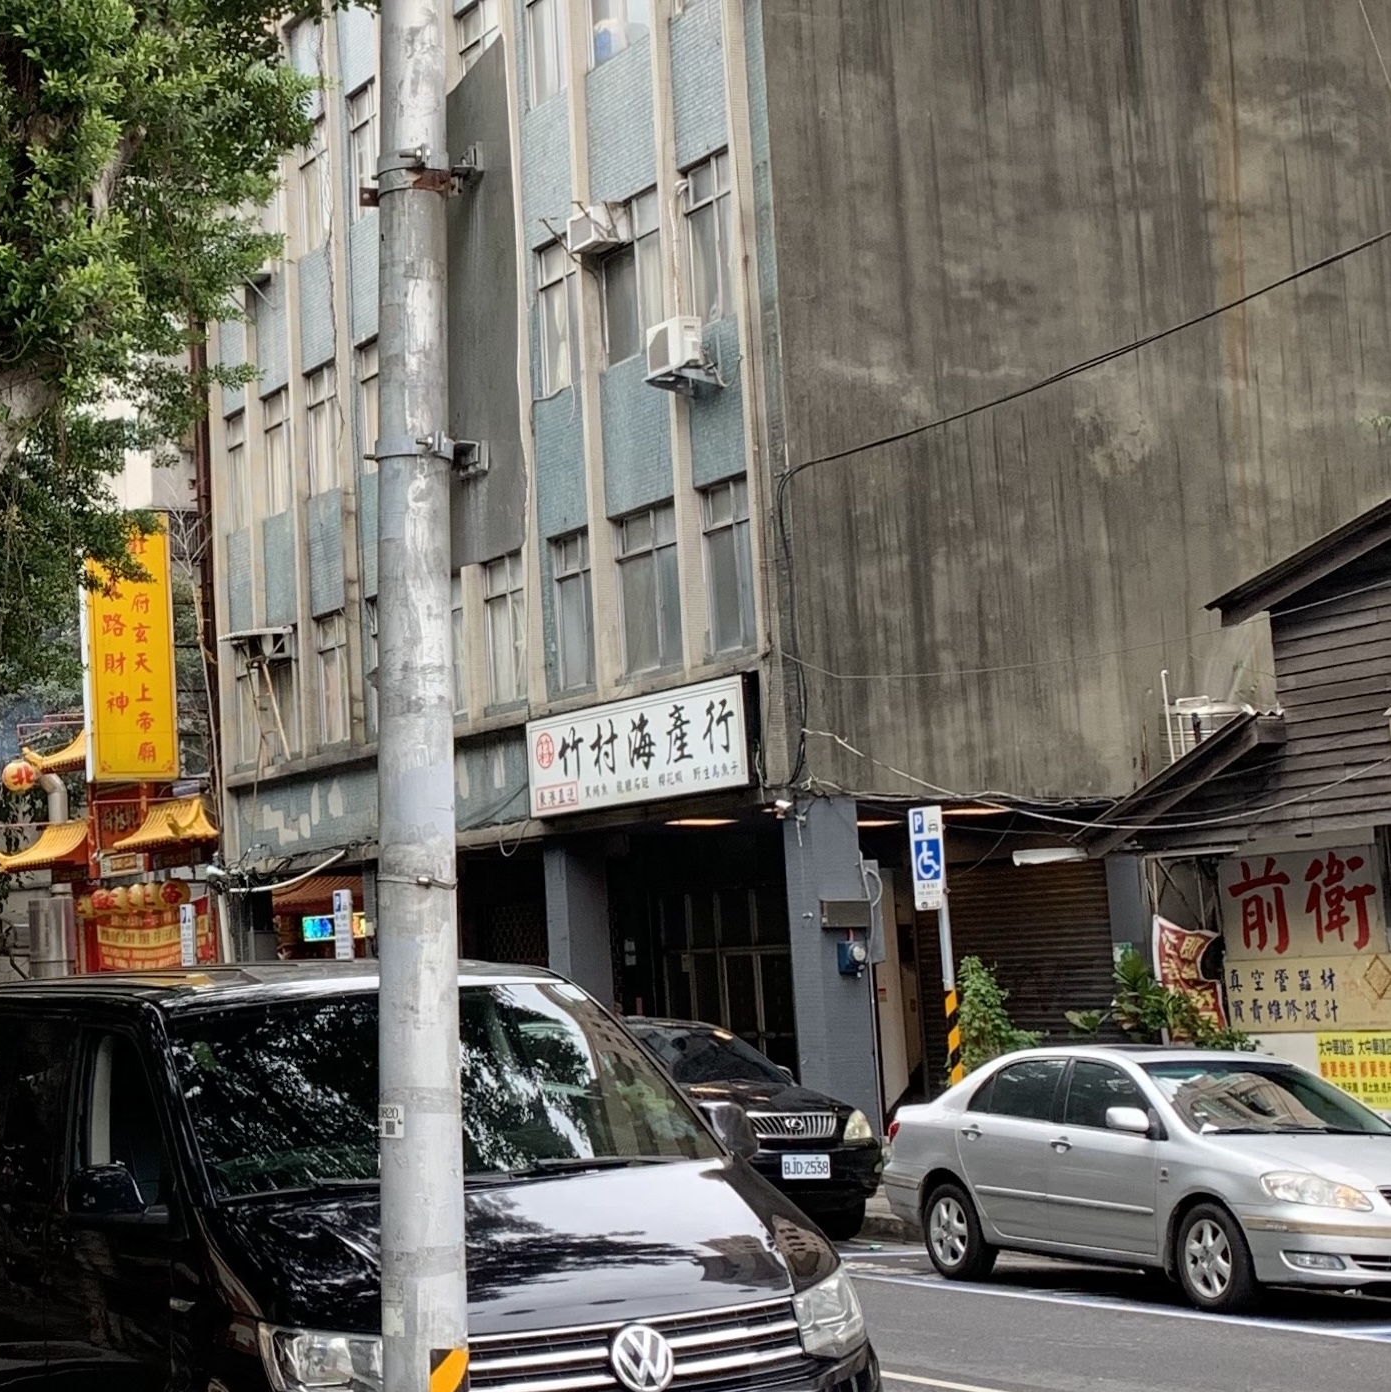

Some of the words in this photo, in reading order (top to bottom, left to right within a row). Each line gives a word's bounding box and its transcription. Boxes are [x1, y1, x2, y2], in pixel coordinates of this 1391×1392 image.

[558, 697, 735, 781] 竹村海產行
[914, 813, 922, 832] P
[1228, 851, 1377, 955] 前衛
[1228, 967, 1336, 993] 真空管器材
[1231, 998, 1339, 1025] 買賣維修設計
[783, 1160, 829, 1175] BJD-2538
